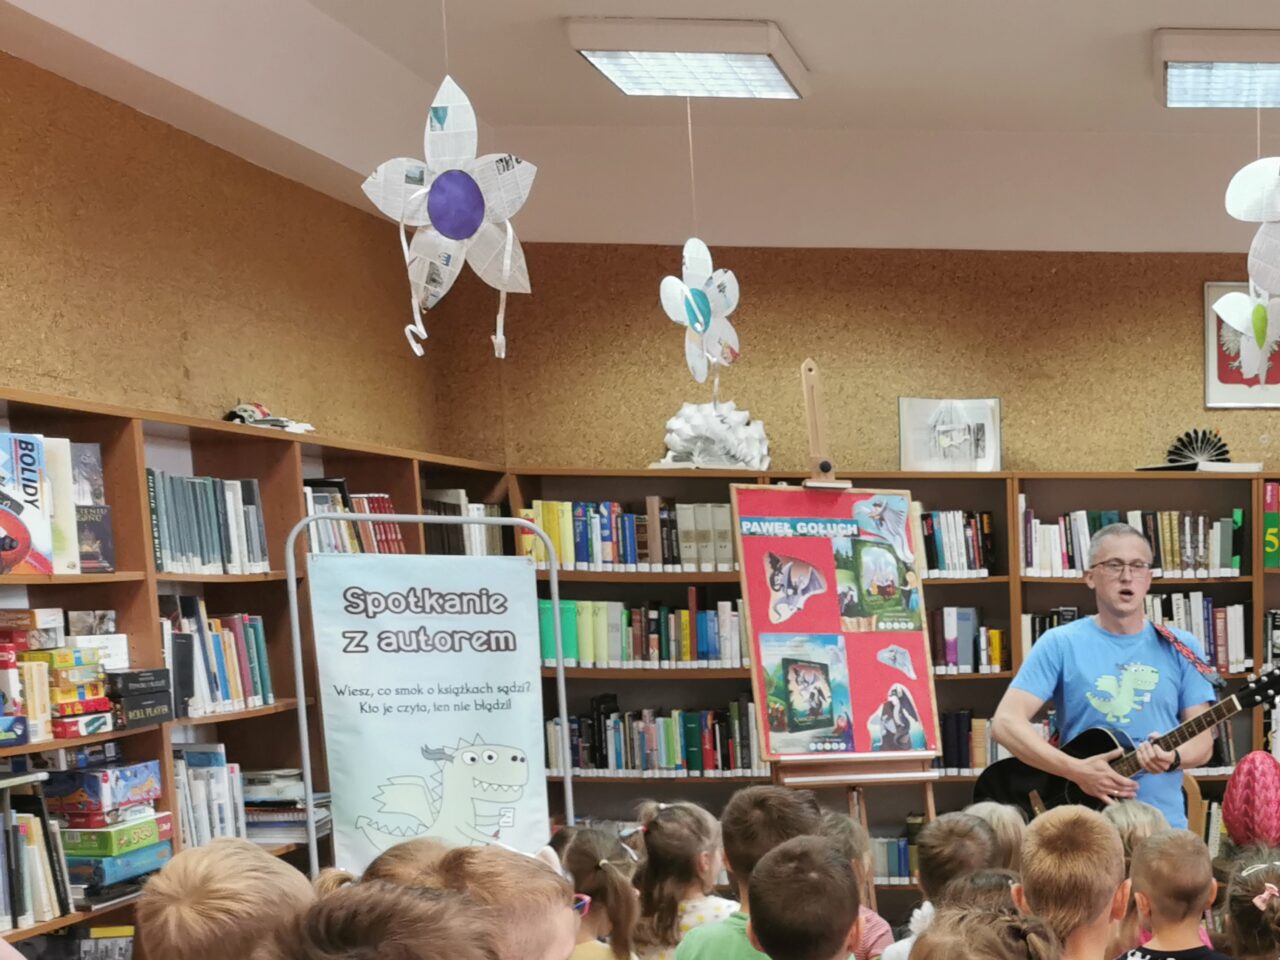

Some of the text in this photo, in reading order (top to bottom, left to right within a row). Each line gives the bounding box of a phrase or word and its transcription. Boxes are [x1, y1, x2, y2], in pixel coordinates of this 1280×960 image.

[18, 439, 40, 510] BOLIDY
[741, 521, 858, 535] PAWEŁ GOŁUCH
[1264, 528, 1279, 553] 5
[343, 586, 508, 619] Spotkanie
[342, 626, 517, 653] z autorem
[333, 681, 531, 698] Wiesz, co smok o książkach sądzi?
[359, 701, 379, 714] Kto
[383, 702, 393, 715] je
[397, 702, 430, 715] czyta,
[433, 702, 450, 712] ten
[454, 702, 471, 712] nie
